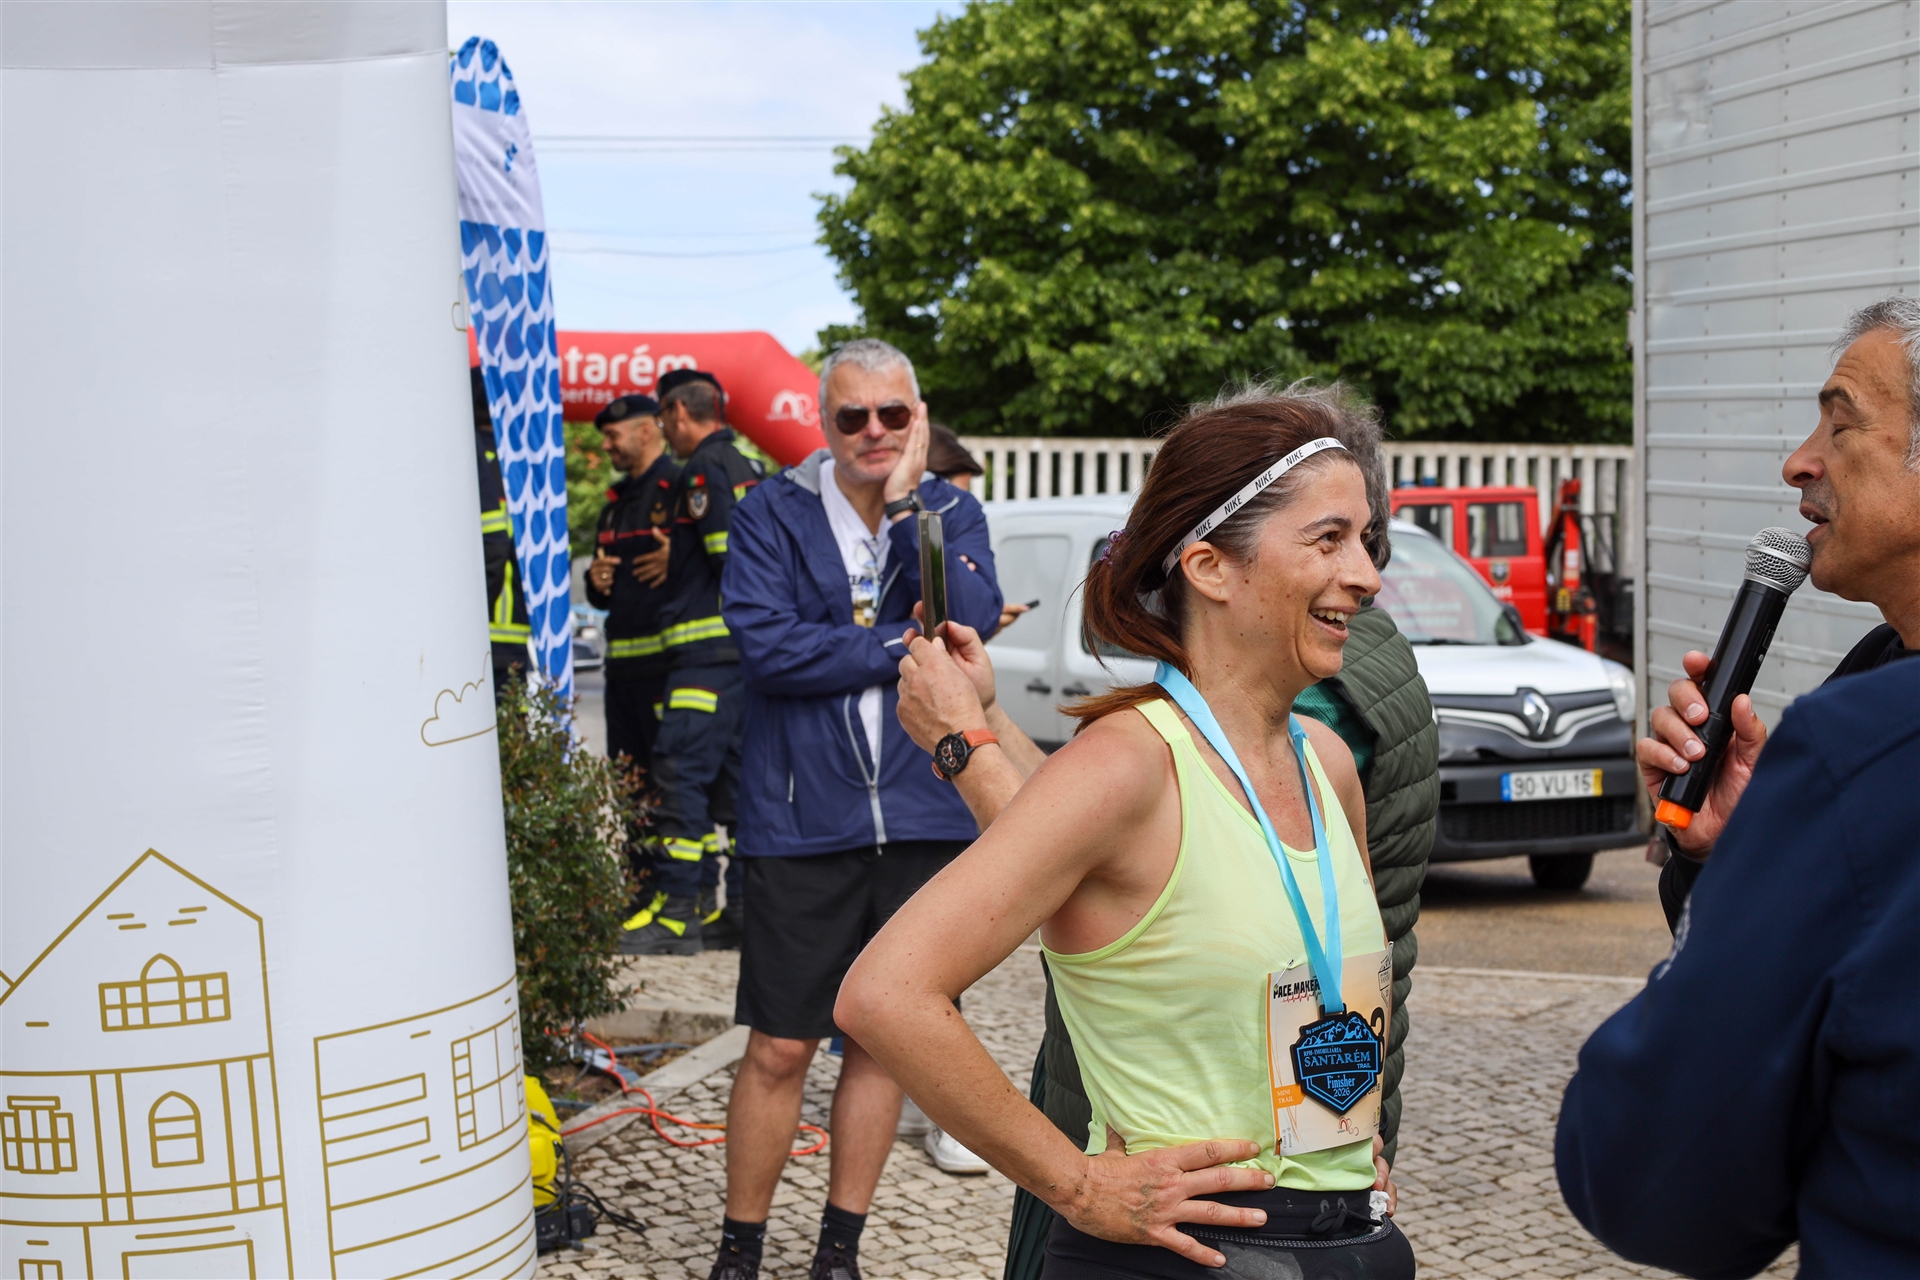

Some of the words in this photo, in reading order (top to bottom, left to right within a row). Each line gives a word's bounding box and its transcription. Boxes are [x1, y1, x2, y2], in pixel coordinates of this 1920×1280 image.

[558, 344, 698, 387] tarém
[1173, 541, 1186, 560] NIKE
[1195, 518, 1213, 539] NIKE
[1224, 494, 1243, 515] NIKE
[1254, 470, 1274, 491] NIKE
[1285, 449, 1304, 467] NIKE
[1313, 439, 1329, 450] NIKE
[1273, 978, 1321, 1000] PACE.MAKER
[1304, 1048, 1371, 1068] SANTARÉM
[1326, 1073, 1356, 1089] Finisher
[1276, 1089, 1291, 1097] MINI
[1277, 1096, 1294, 1104] TRAIL
[1333, 1087, 1351, 1098] 2026
